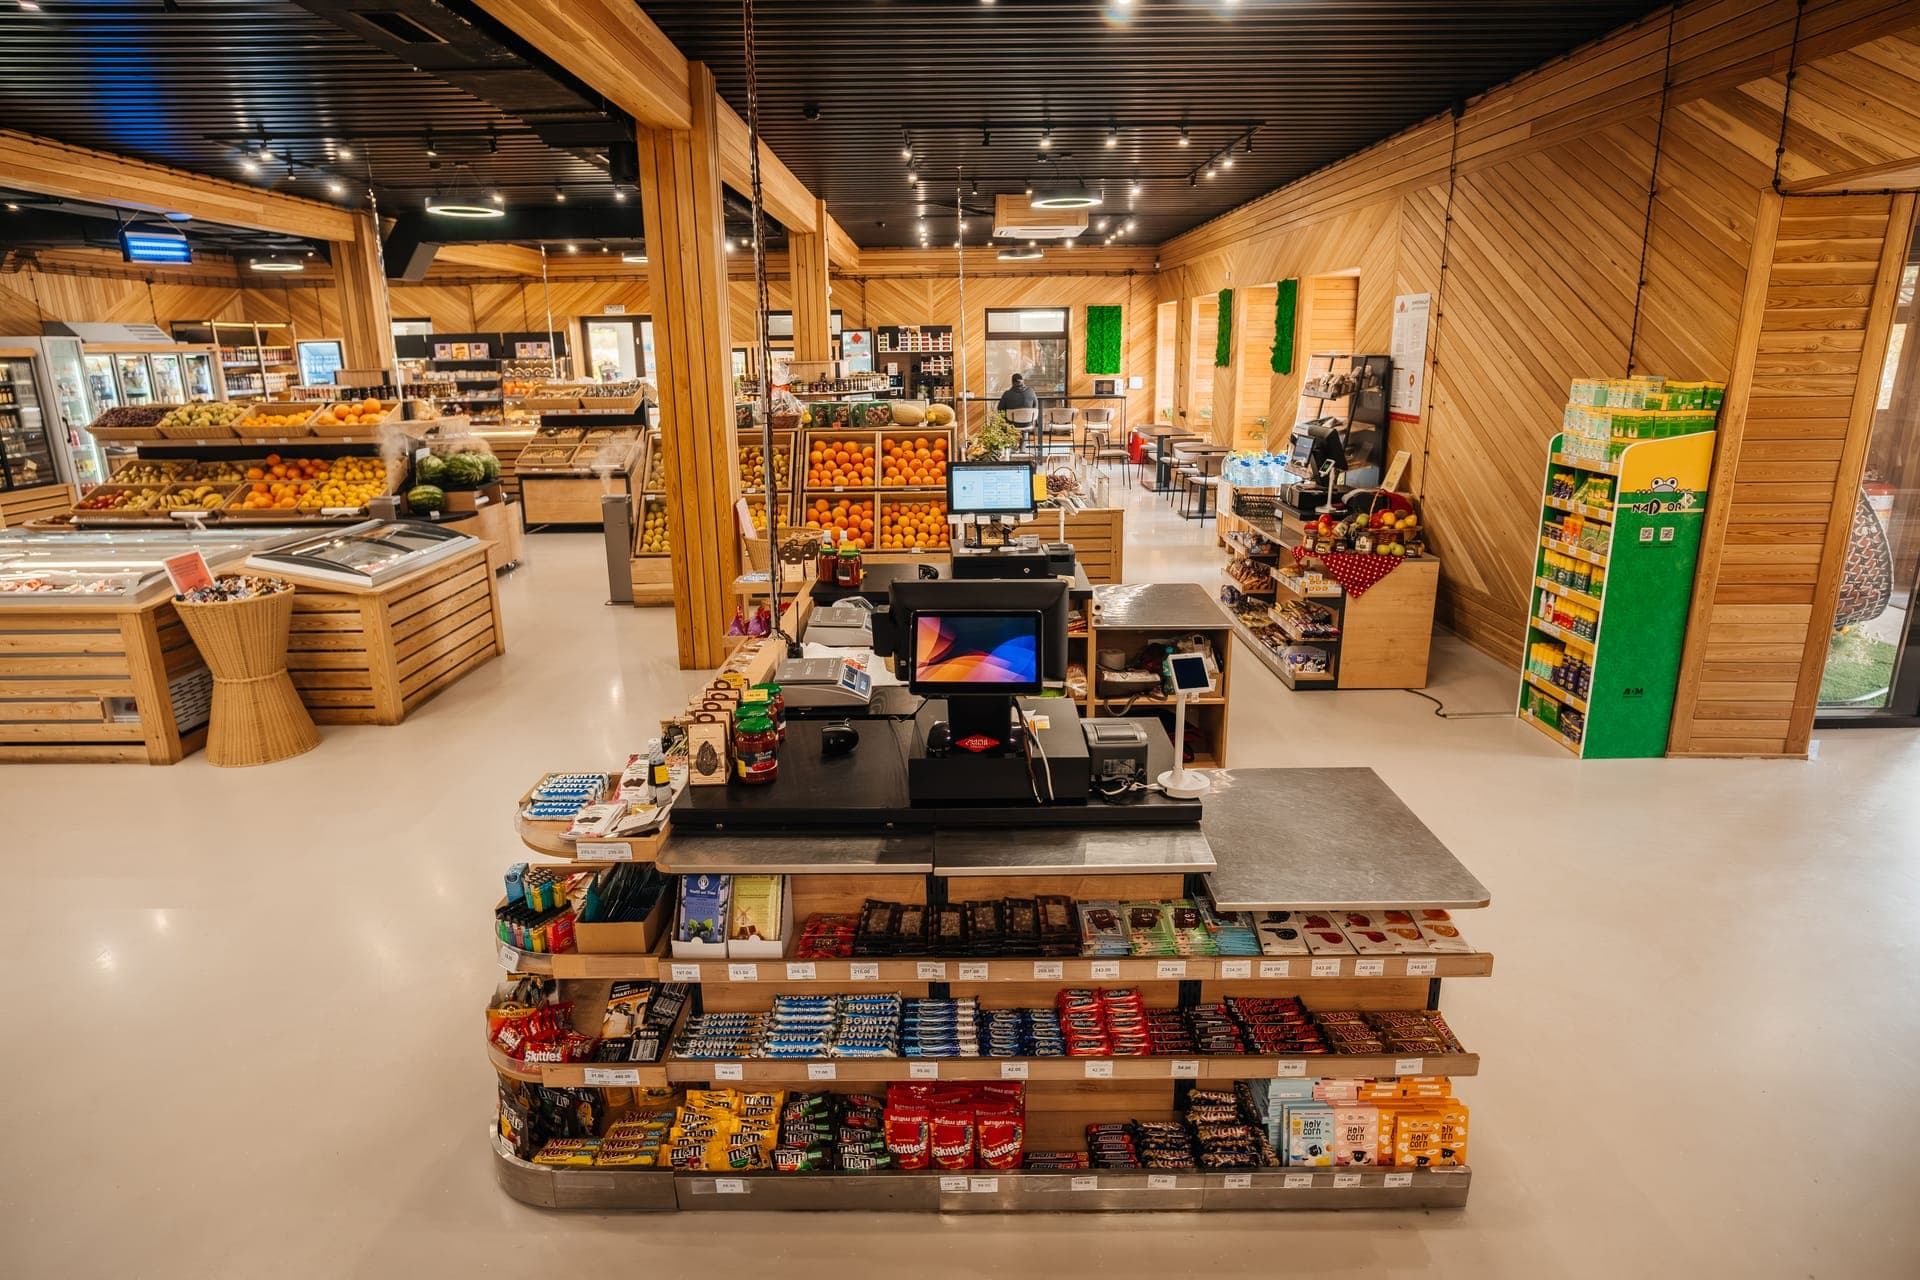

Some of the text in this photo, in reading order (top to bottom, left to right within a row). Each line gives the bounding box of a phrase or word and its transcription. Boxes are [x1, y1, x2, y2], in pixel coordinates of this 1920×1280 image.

[847, 1002, 895, 1010] BOUNTY
[845, 1016, 892, 1024] BOUNTY
[689, 1040, 738, 1048] BOUNTY
[525, 1050, 562, 1062] Skittles
[686, 1048, 735, 1056] BOUNTY
[889, 1142, 927, 1154] Skittles
[932, 1142, 971, 1156] Skittles
[982, 1141, 1021, 1158] Skittles
